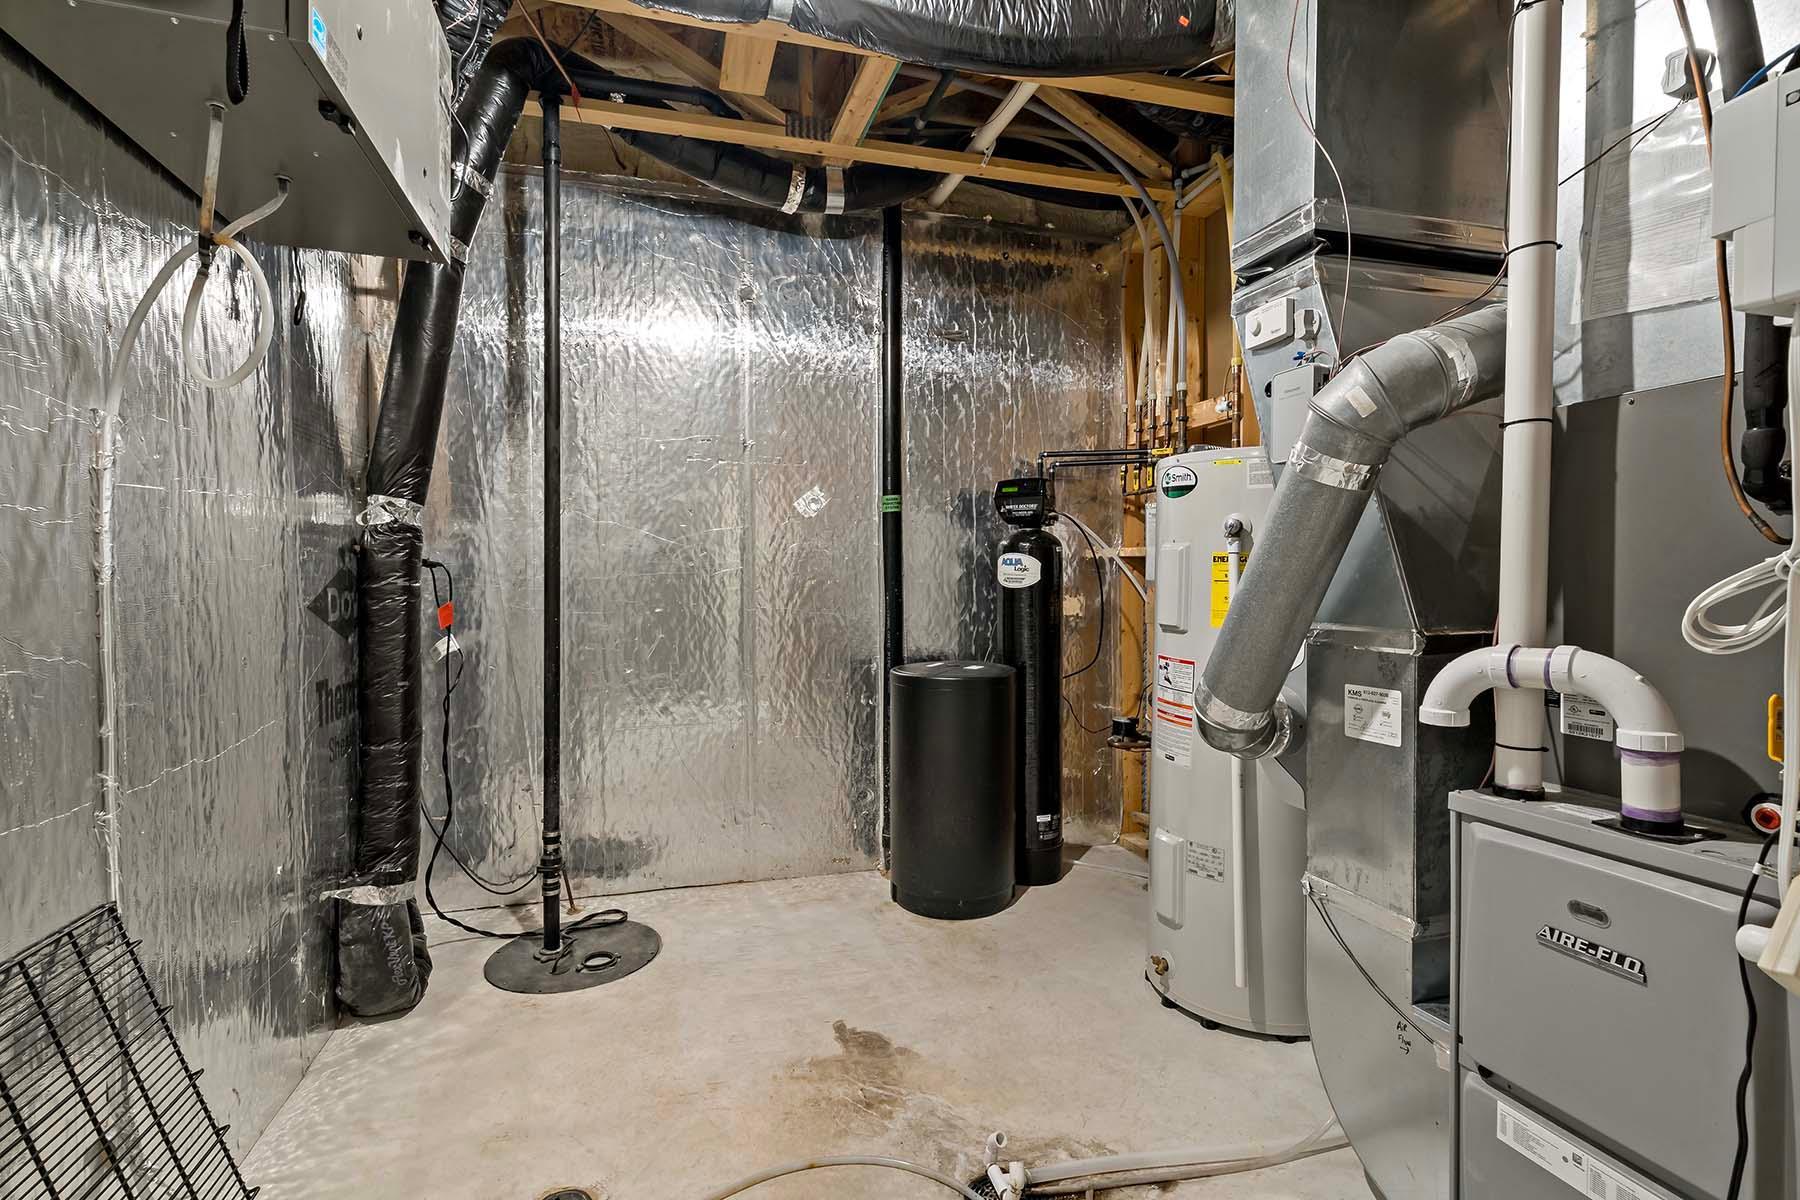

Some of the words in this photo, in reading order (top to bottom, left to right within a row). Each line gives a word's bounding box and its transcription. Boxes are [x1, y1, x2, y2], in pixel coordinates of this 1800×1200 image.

[1172, 472, 1192, 483] Smith
[1002, 557, 1024, 567] AQUA
[1014, 565, 1030, 573] Logic
[327, 586, 357, 622] Do
[1347, 689, 1362, 698] KMS
[1537, 925, 1643, 975] AIRE-FLO
